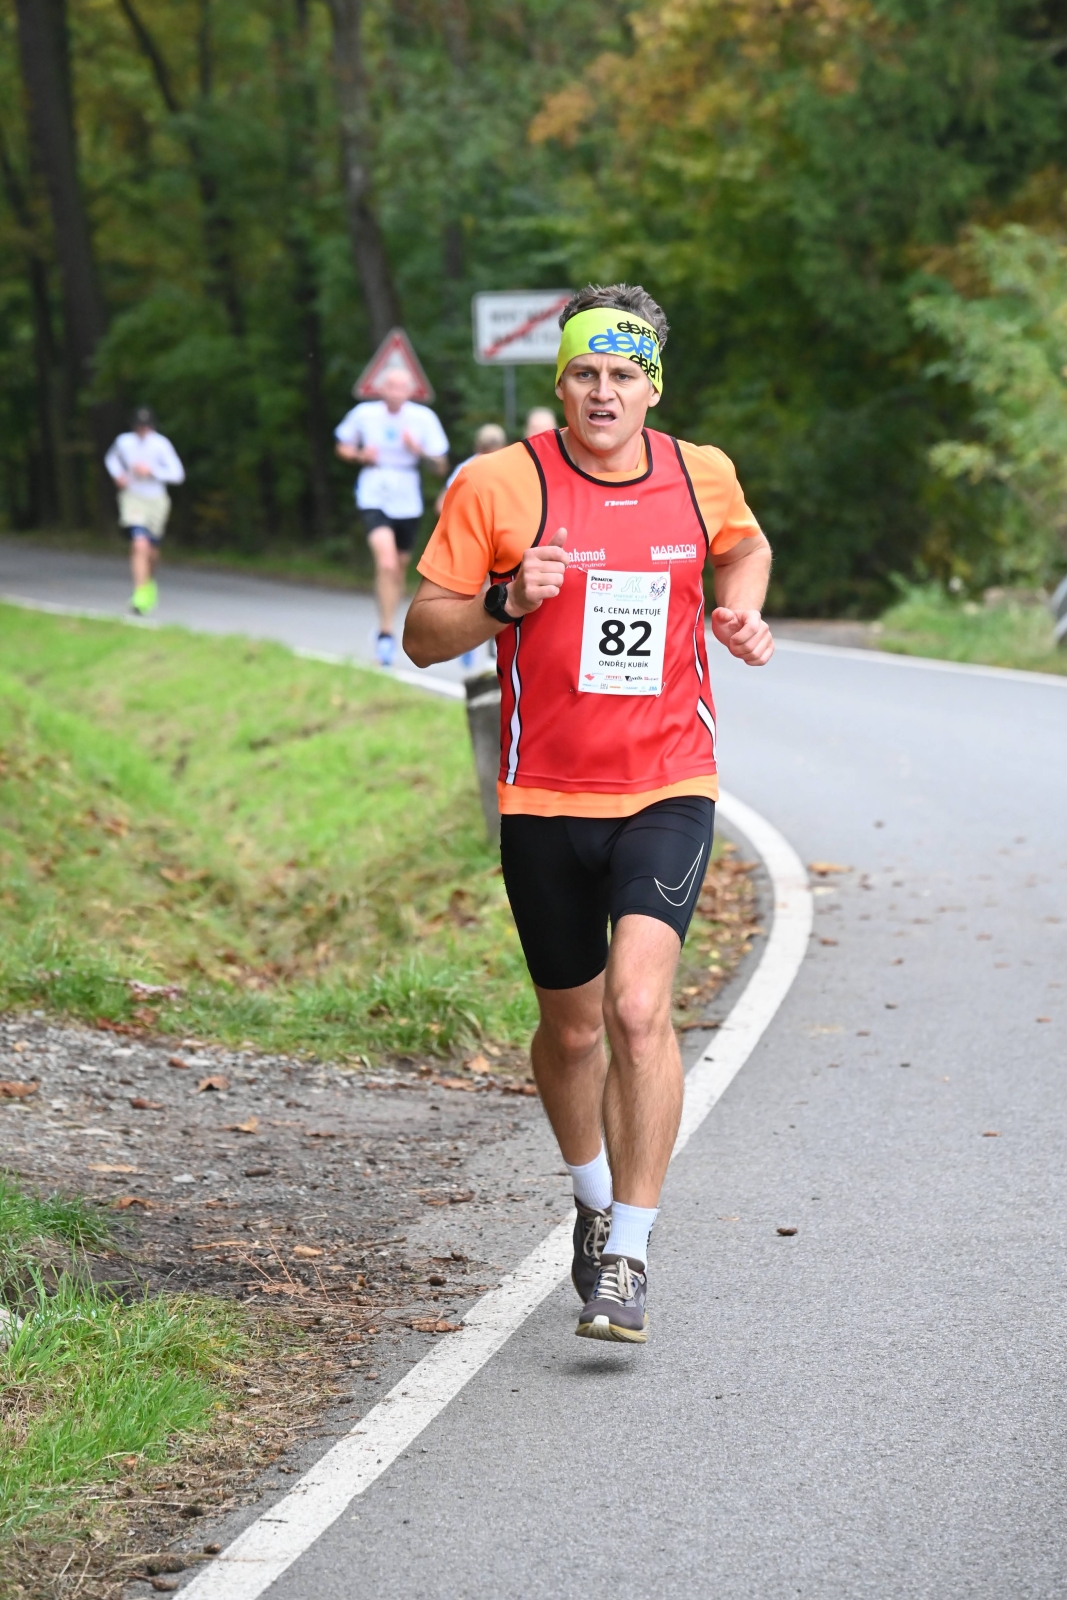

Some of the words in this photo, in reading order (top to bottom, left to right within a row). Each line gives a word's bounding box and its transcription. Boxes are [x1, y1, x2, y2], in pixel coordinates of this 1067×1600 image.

[567, 548, 606, 562] akonoš
[650, 543, 697, 555] MARATON
[590, 582, 613, 592] CUP
[593, 605, 606, 614] 64.
[607, 607, 630, 615] CENA
[632, 608, 661, 617] METUJE
[598, 619, 652, 657] 82
[598, 659, 627, 669] ONDŘEJ
[627, 660, 649, 668] KUBÍK
